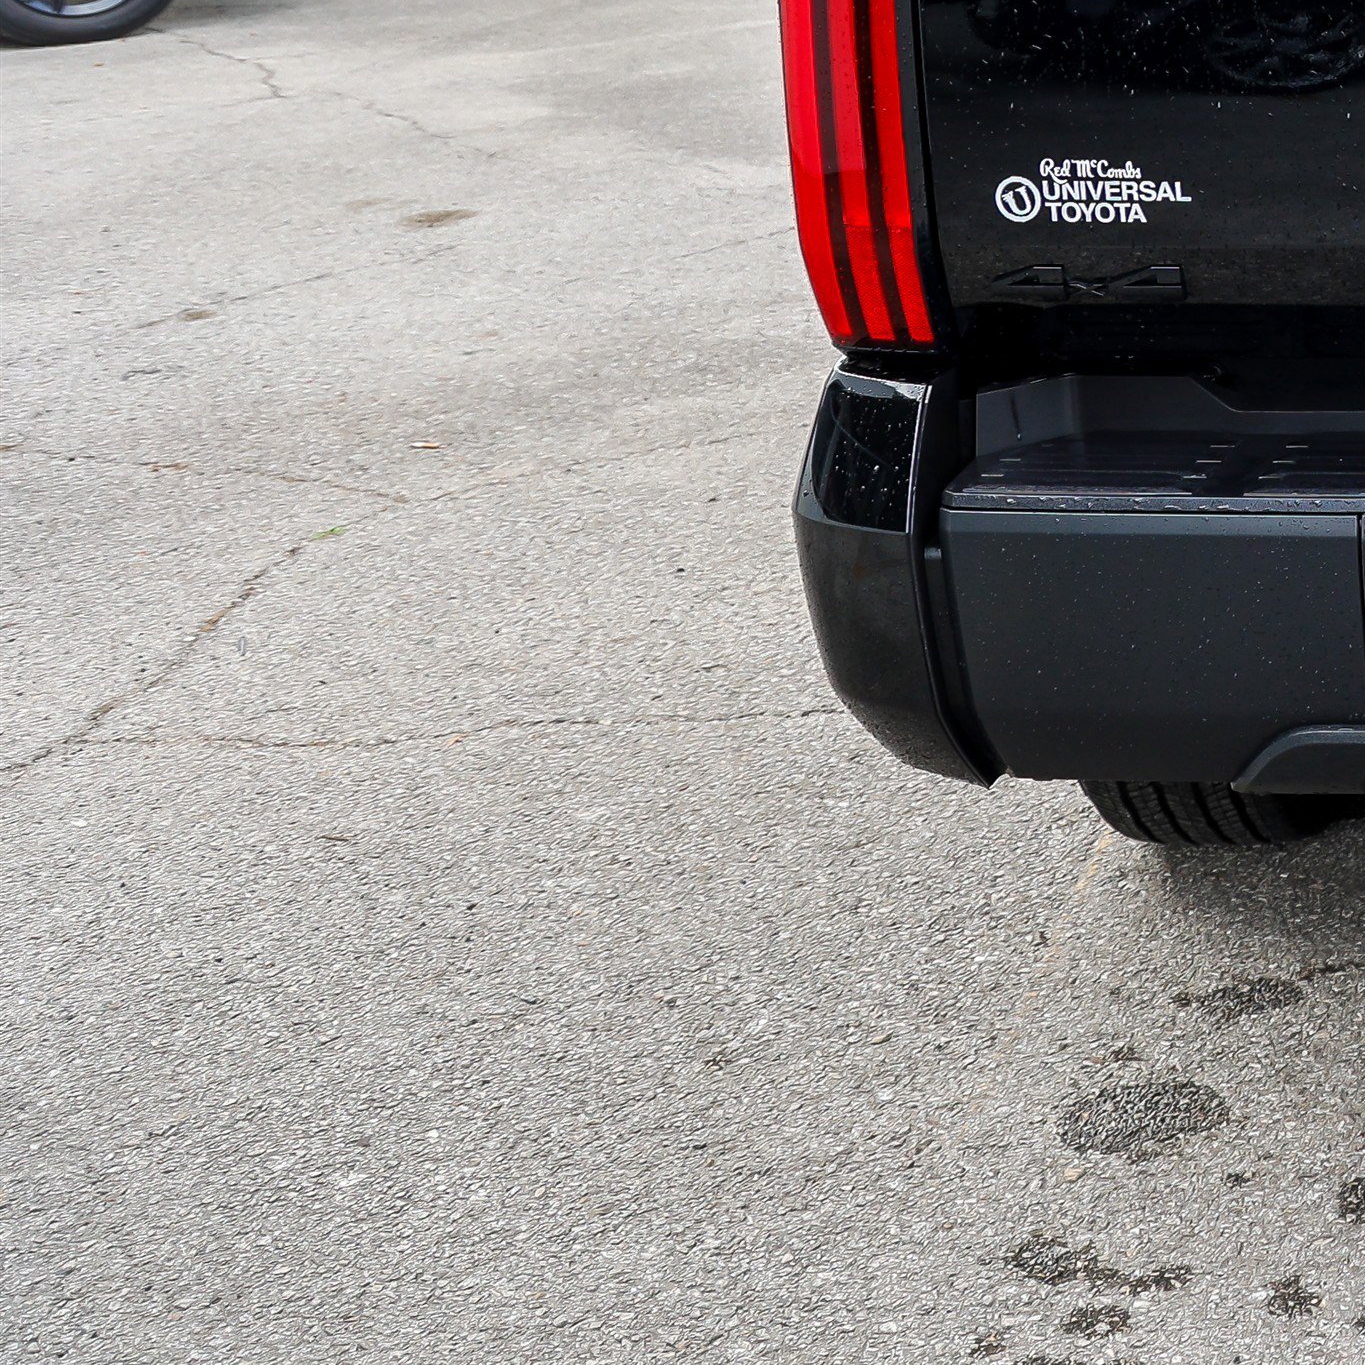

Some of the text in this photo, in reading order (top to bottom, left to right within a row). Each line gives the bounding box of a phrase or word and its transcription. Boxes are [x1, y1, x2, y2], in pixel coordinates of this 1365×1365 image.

[1039, 158, 1142, 184] Red McCombs
[1042, 180, 1192, 203] UNIVERSAL
[1045, 202, 1147, 223] TOYOTA
